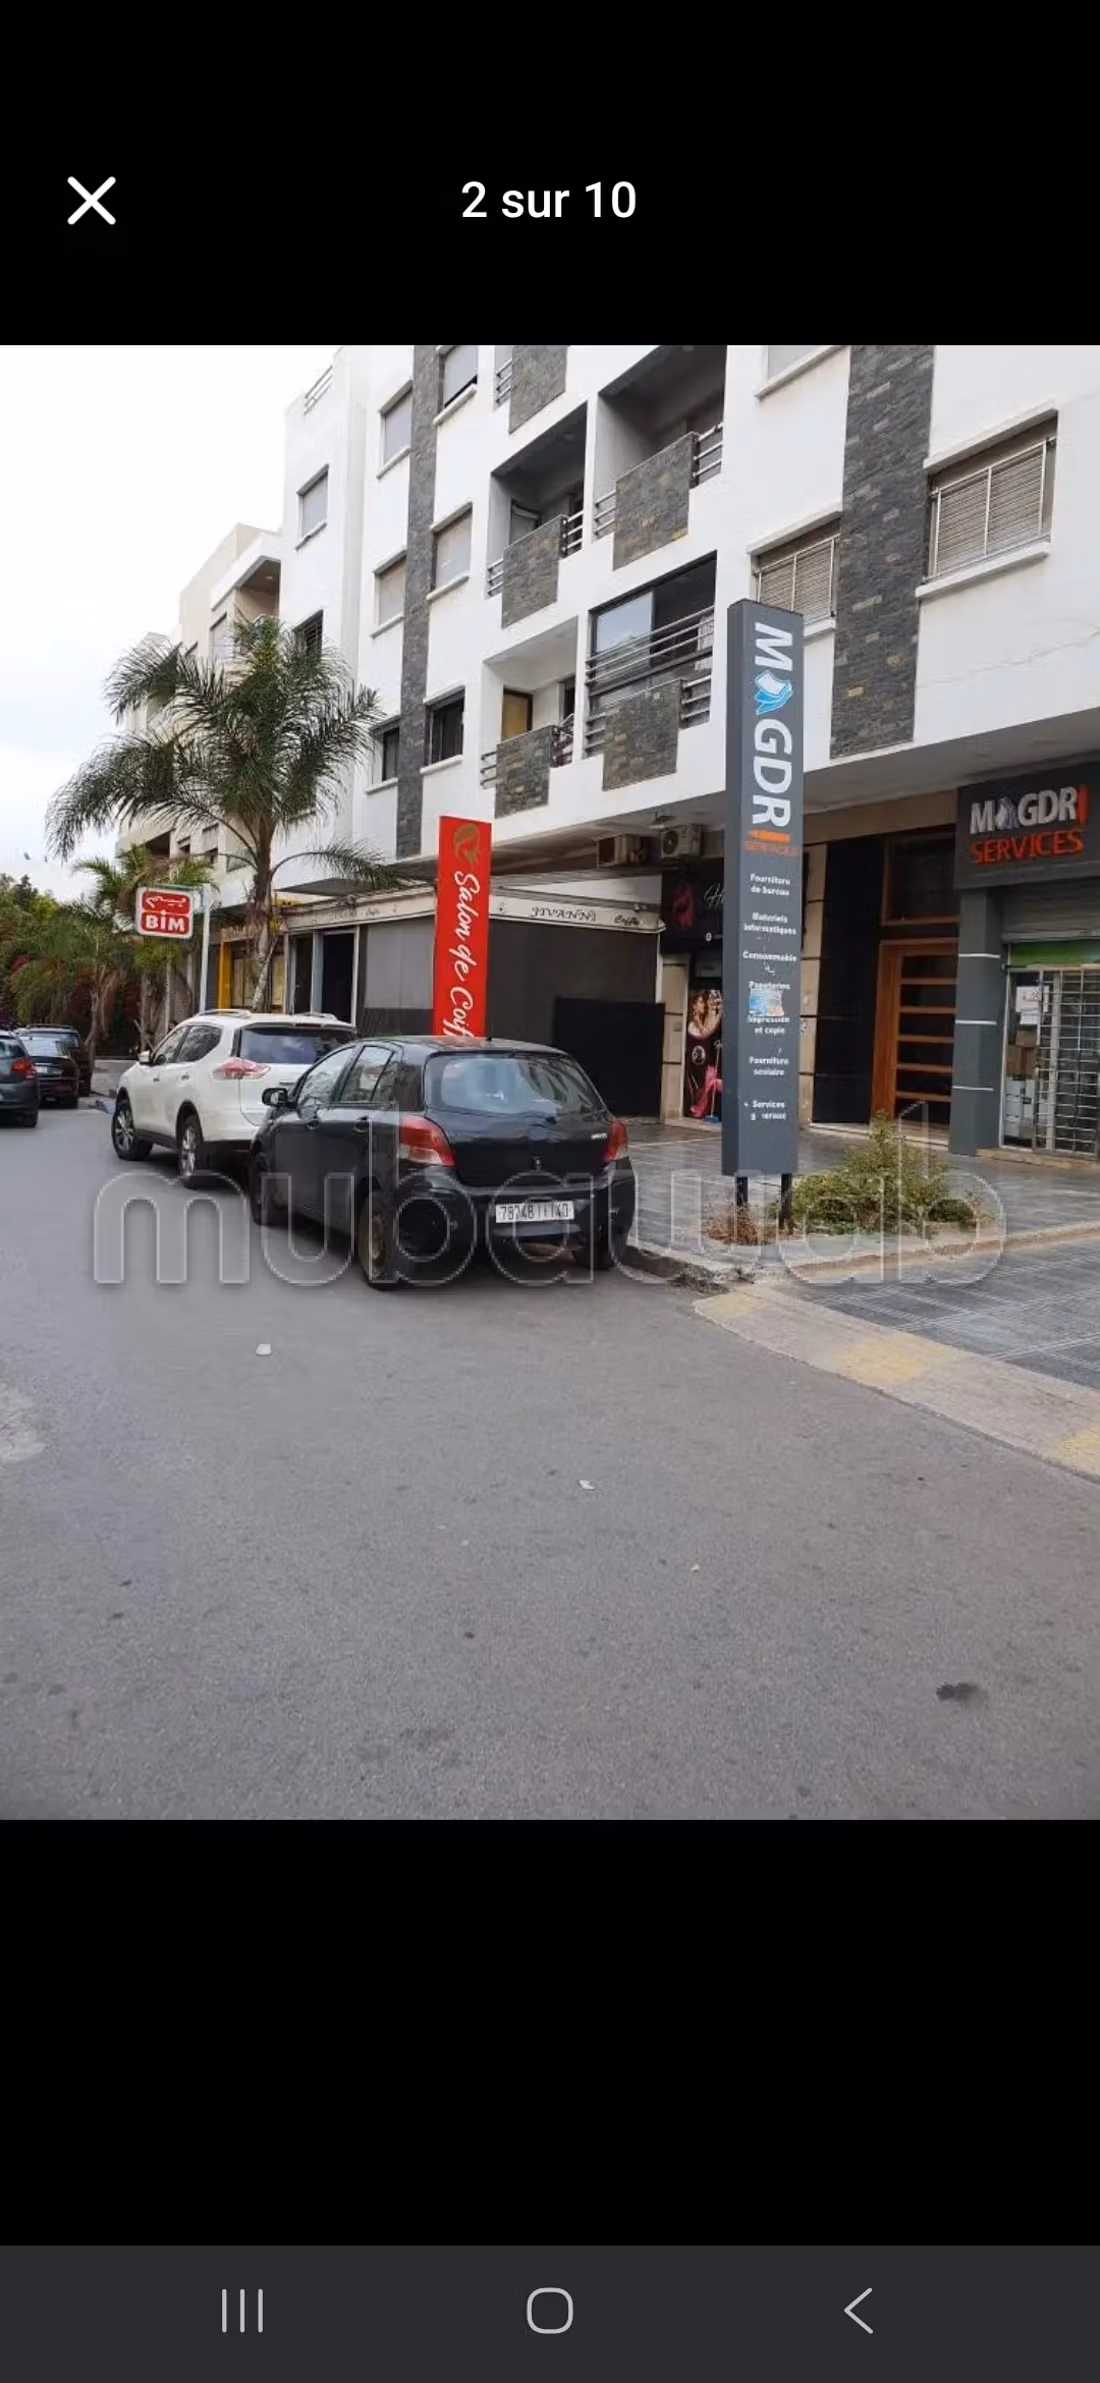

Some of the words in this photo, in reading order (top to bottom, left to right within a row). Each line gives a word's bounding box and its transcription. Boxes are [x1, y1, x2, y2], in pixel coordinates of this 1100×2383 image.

[969, 830, 1085, 866] SERVICES
[750, 874, 791, 885] Fourniture
[454, 870, 481, 942] Salon
[749, 1056, 789, 1065] Fourniture
[752, 1100, 785, 1109] Services
